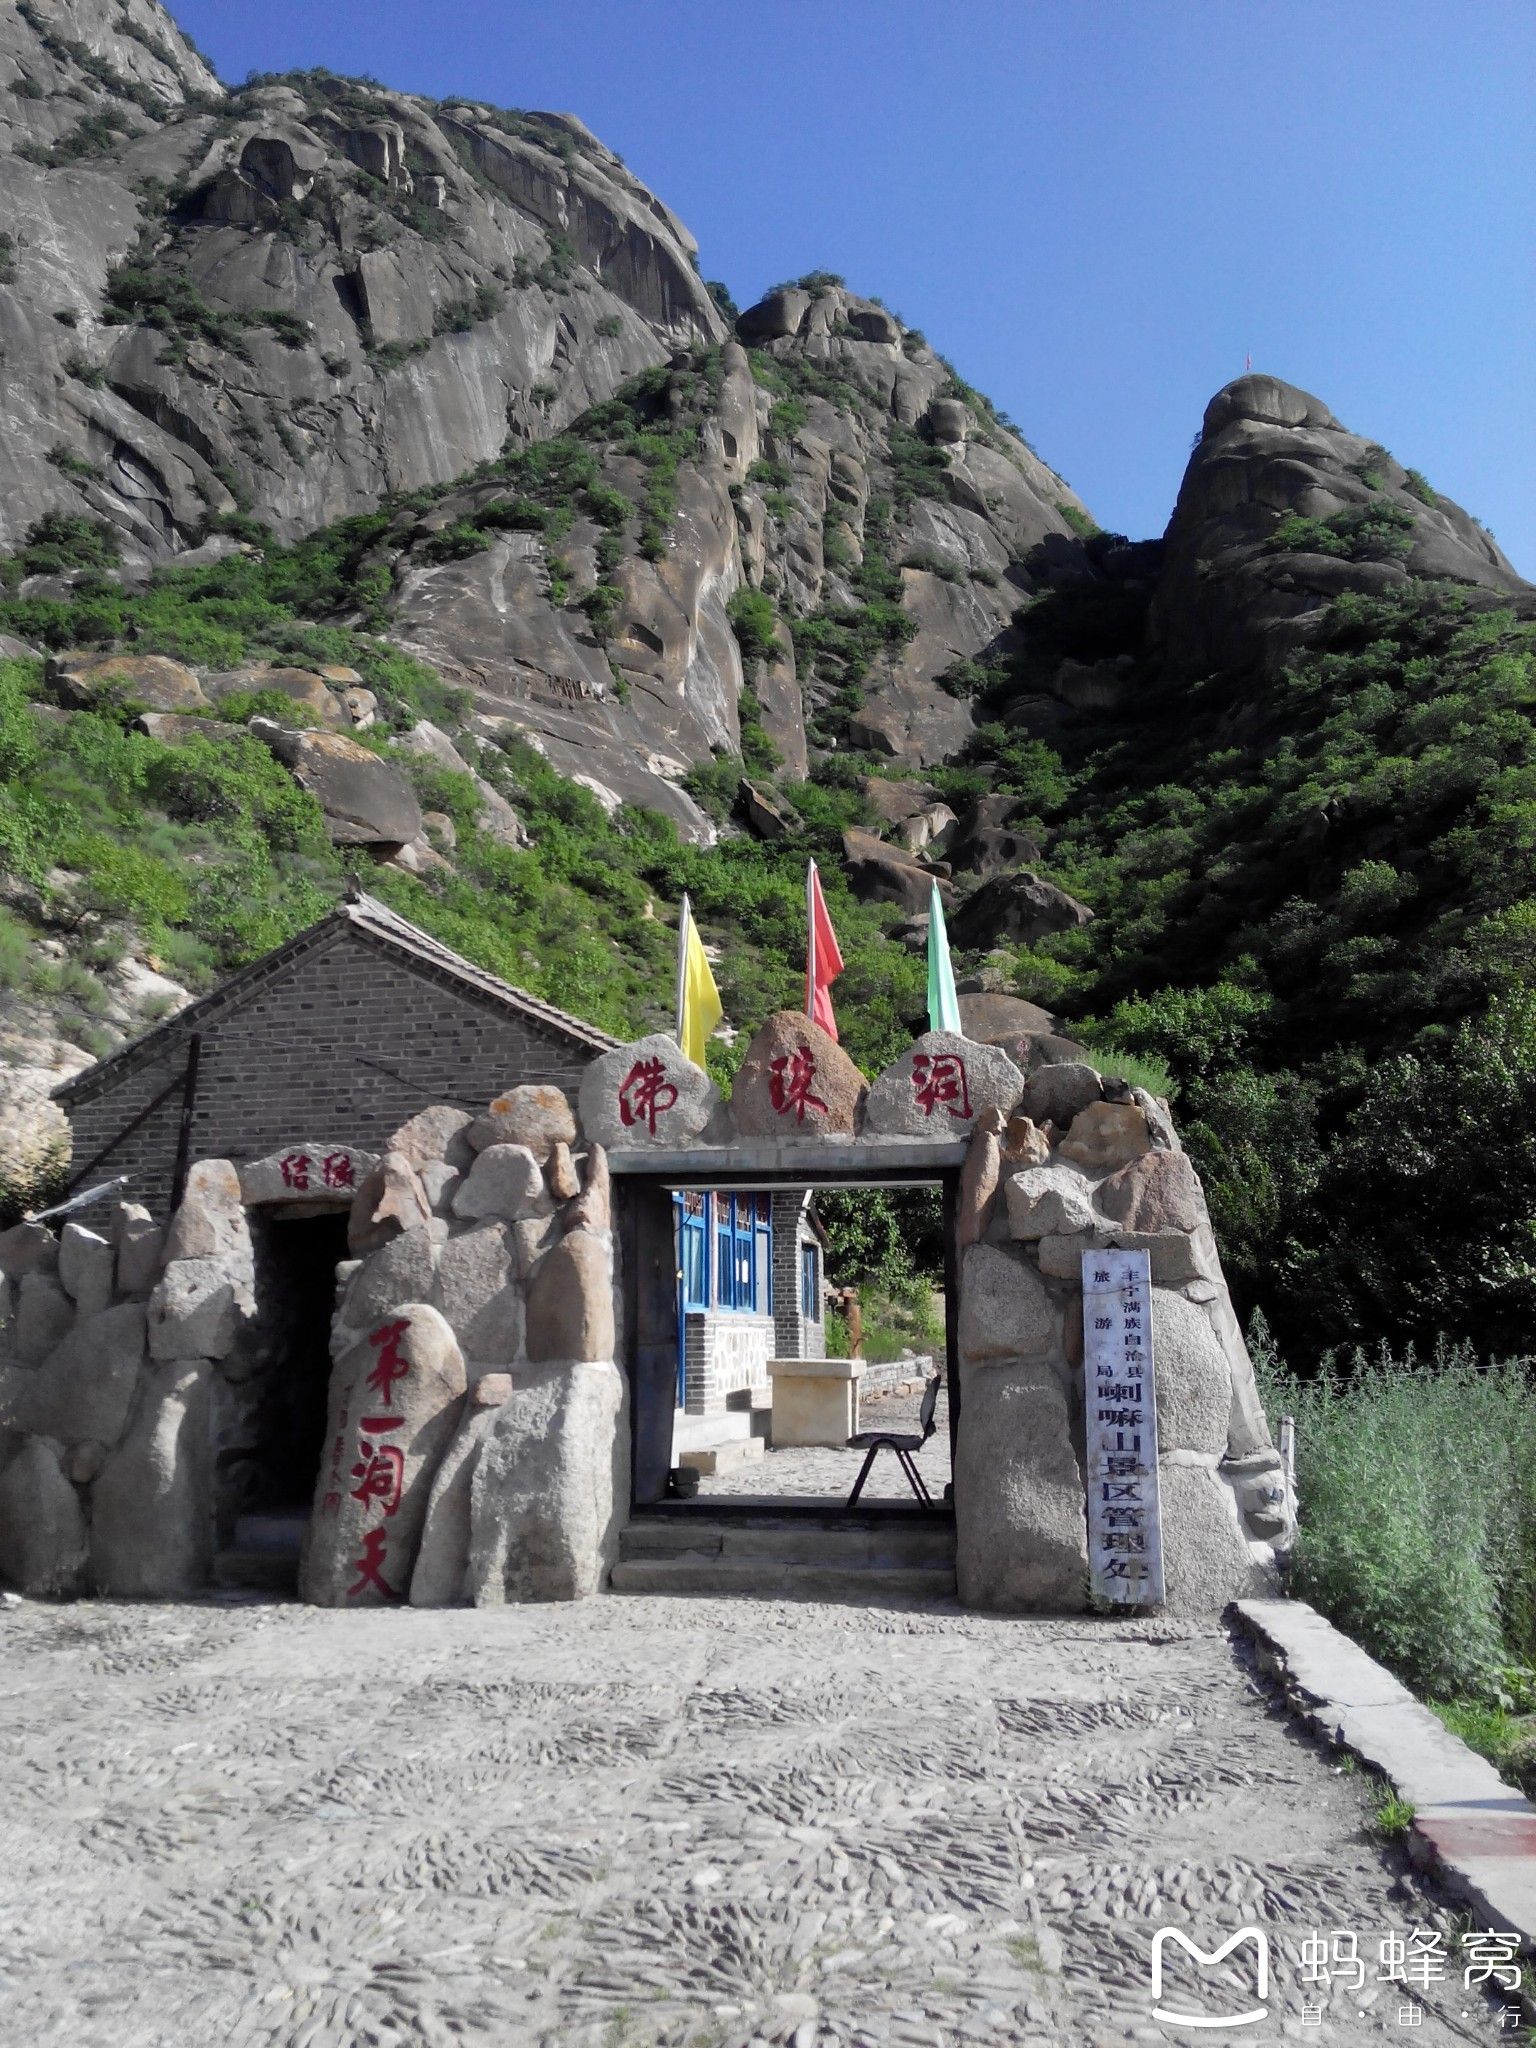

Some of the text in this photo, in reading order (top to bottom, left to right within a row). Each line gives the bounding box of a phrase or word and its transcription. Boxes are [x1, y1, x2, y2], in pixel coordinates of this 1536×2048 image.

[1093, 1270, 1114, 1378] 旅游局
[1097, 1382, 1149, 1580] 喇嘛山景区管理处
